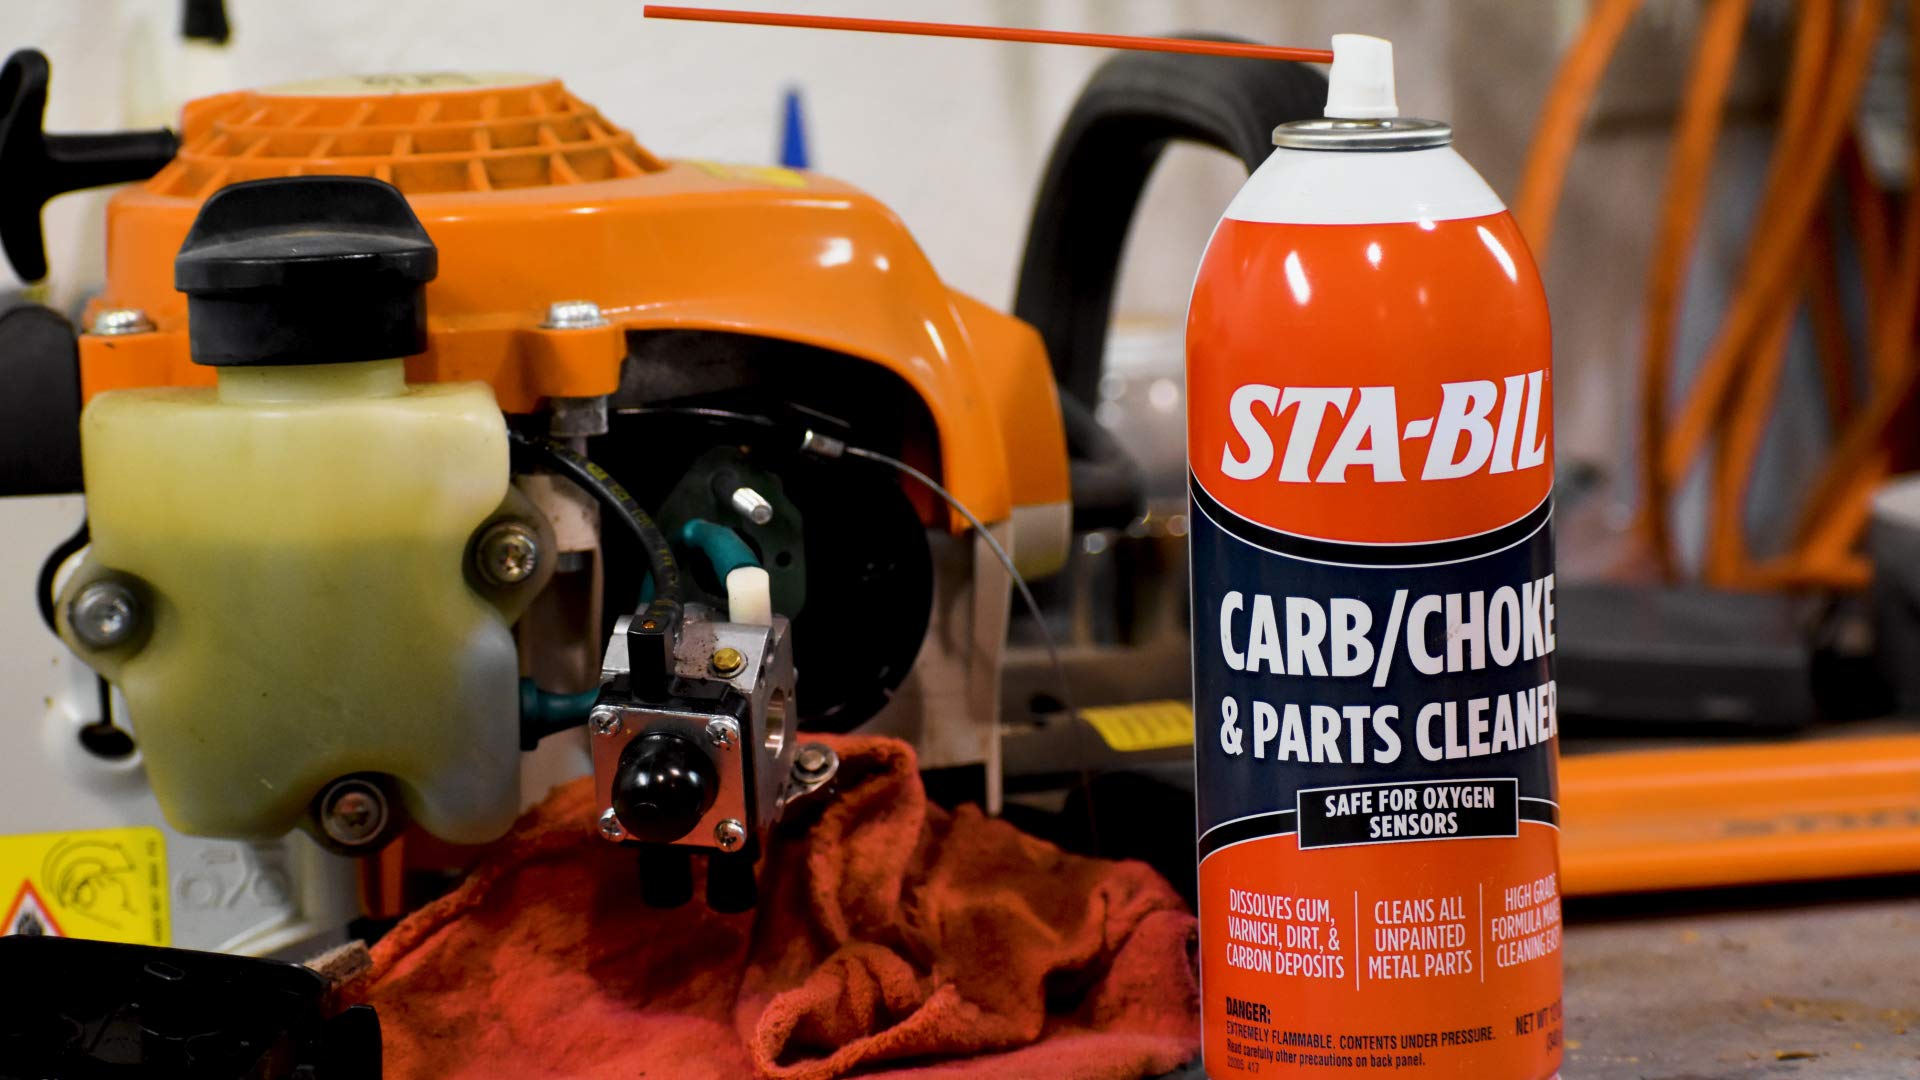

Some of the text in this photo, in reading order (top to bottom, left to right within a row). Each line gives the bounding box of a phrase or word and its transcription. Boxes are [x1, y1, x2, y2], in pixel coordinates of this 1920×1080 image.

[1220, 369, 1546, 483] STA-BIL
[1220, 574, 1555, 687] CARB/CHOKE
[1221, 696, 1243, 755] &
[1253, 701, 1401, 764] PARTS
[1415, 681, 1557, 761] CLEANER
[1325, 786, 1494, 817] SAFE FOR OXYGEN
[1369, 812, 1458, 838] SENSORS
[1230, 888, 1335, 926] DISSOLVES GUM,
[1374, 896, 1466, 925] CLEANS ALL
[1505, 883, 1532, 912] HIGH
[1228, 915, 1340, 953] VARNISH, DIRT, &
[1375, 924, 1466, 952] UNPAINTED
[1491, 907, 1542, 942] FORMULA
[1226, 942, 1344, 979] CARBON DEPOSITS
[1369, 949, 1473, 979] METAL PARTS
[1496, 932, 1546, 968] CLEANING
[1226, 996, 1271, 1024] DANGER:
[1515, 1012, 1534, 1036] NET
[1226, 1020, 1496, 1051] EXTREMELY FLAMMABLE. CONTENTS UNDER PRESSURE.
[1227, 1038, 1426, 1070] Read carefully other precautions on back panel.
